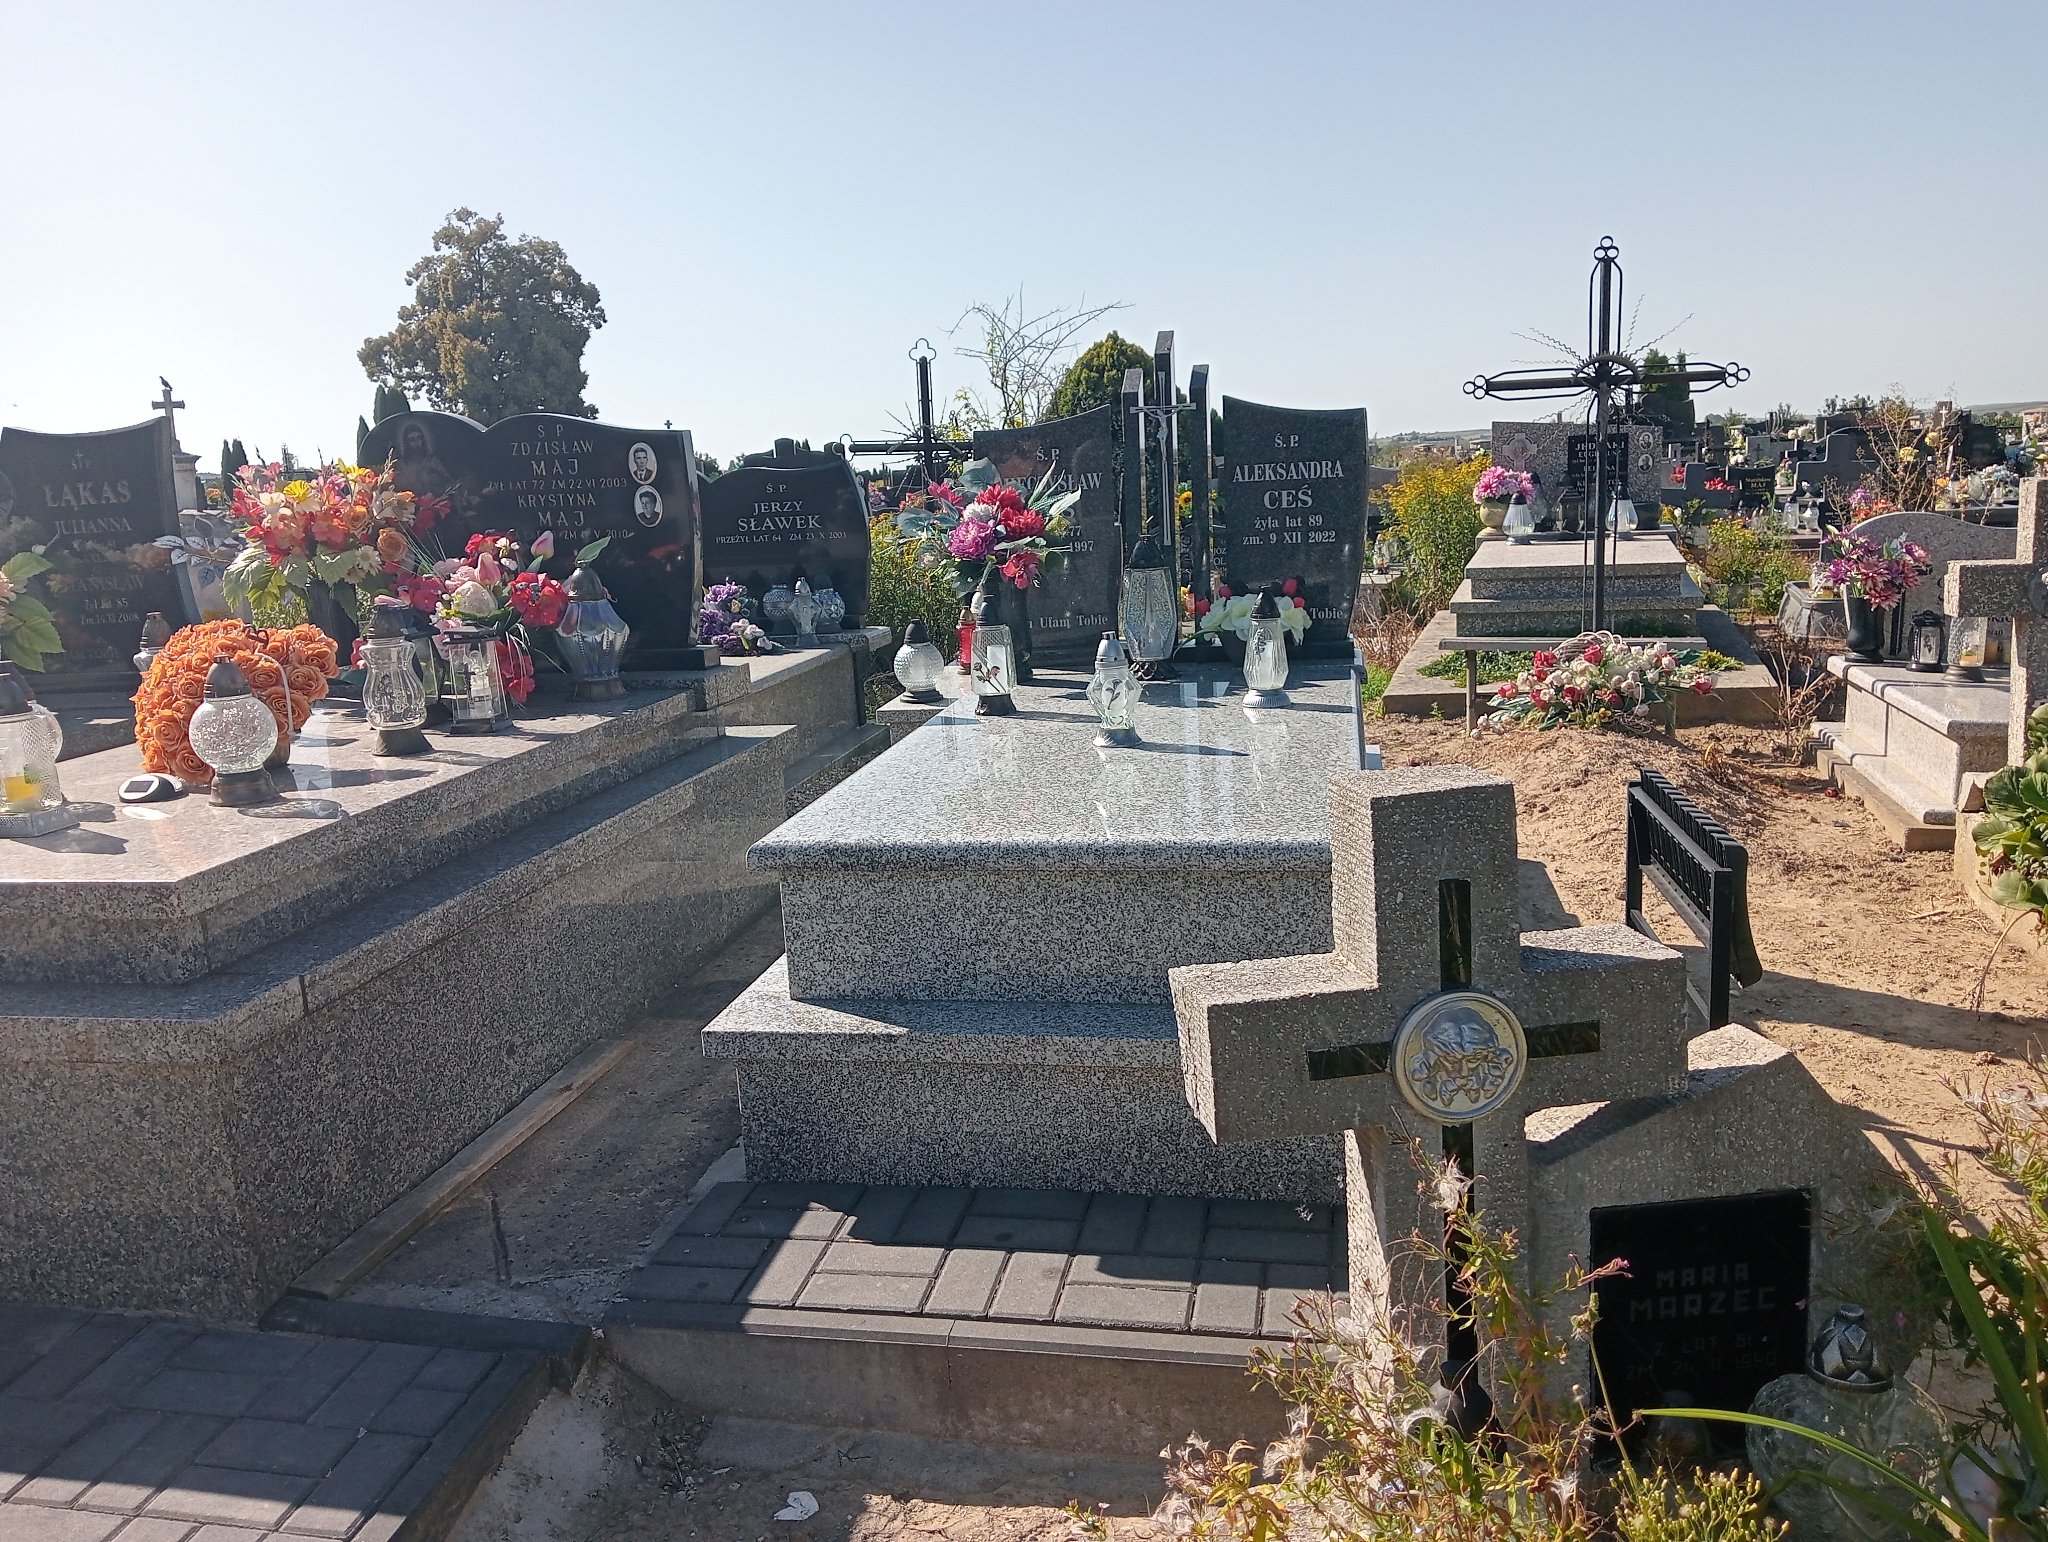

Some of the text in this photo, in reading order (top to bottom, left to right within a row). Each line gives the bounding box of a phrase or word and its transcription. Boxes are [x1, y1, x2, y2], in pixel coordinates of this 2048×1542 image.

[511, 440, 594, 456] ZDZISŁAW
[531, 458, 579, 476] MAJ
[1232, 460, 1344, 482] ALEKSANDRA
[531, 479, 546, 490] 72
[599, 477, 628, 488] 2003
[517, 493, 597, 508] KRYSTYNA
[1263, 484, 1313, 510] CEŚ
[753, 501, 803, 515] JERZY
[538, 510, 584, 527] MAJ
[737, 514, 823, 532] SŁAWEK
[1285, 515, 1302, 528] lat
[1308, 513, 1323, 527] 89
[55, 517, 132, 538] JULIANNA
[753, 534, 769, 543] LAT
[772, 534, 782, 543] 64
[829, 531, 847, 540] 2003
[1242, 530, 1336, 545] zm. 9 XII 2022
[1069, 540, 1095, 553] 1997
[1040, 616, 1071, 629] Ufam
[1075, 613, 1109, 627] Tobie
[1655, 1262, 1750, 1290] MARIA
[1629, 1286, 1776, 1323] MARZEC
